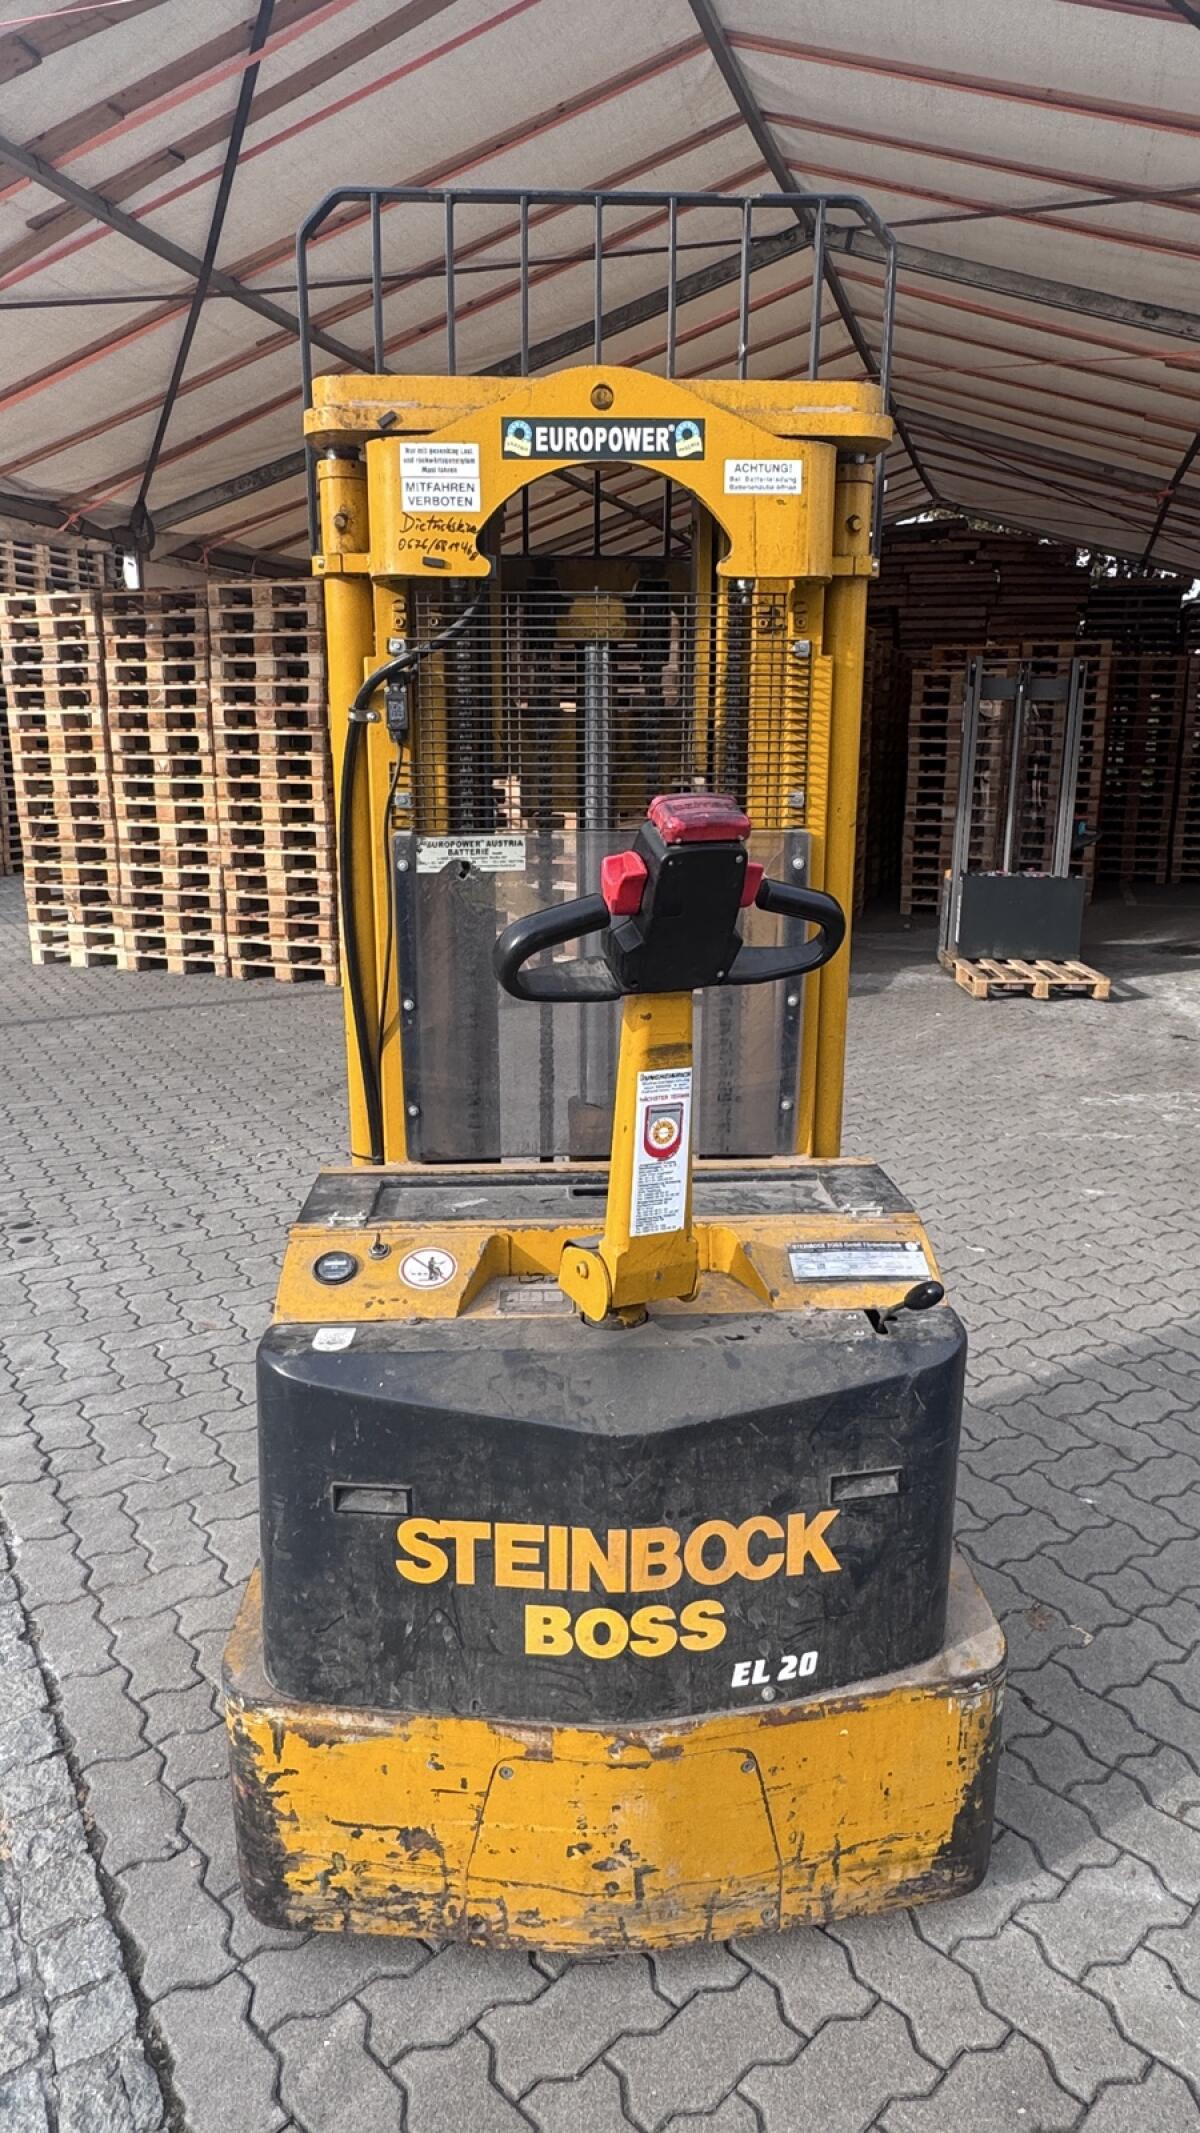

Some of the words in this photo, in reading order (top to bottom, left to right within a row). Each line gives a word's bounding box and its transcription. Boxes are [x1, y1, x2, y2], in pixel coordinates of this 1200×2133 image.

[535, 426, 670, 452] EUROPOWER
[734, 463, 793, 473] ACHTUNG!
[405, 482, 475, 493] MITFAHREN
[408, 495, 473, 507] VERBOTEN
[395, 1508, 841, 1593] STEINBOCK
[524, 1599, 727, 1659] BOSS
[731, 1659, 770, 1688] EL
[776, 1650, 819, 1679] 20
